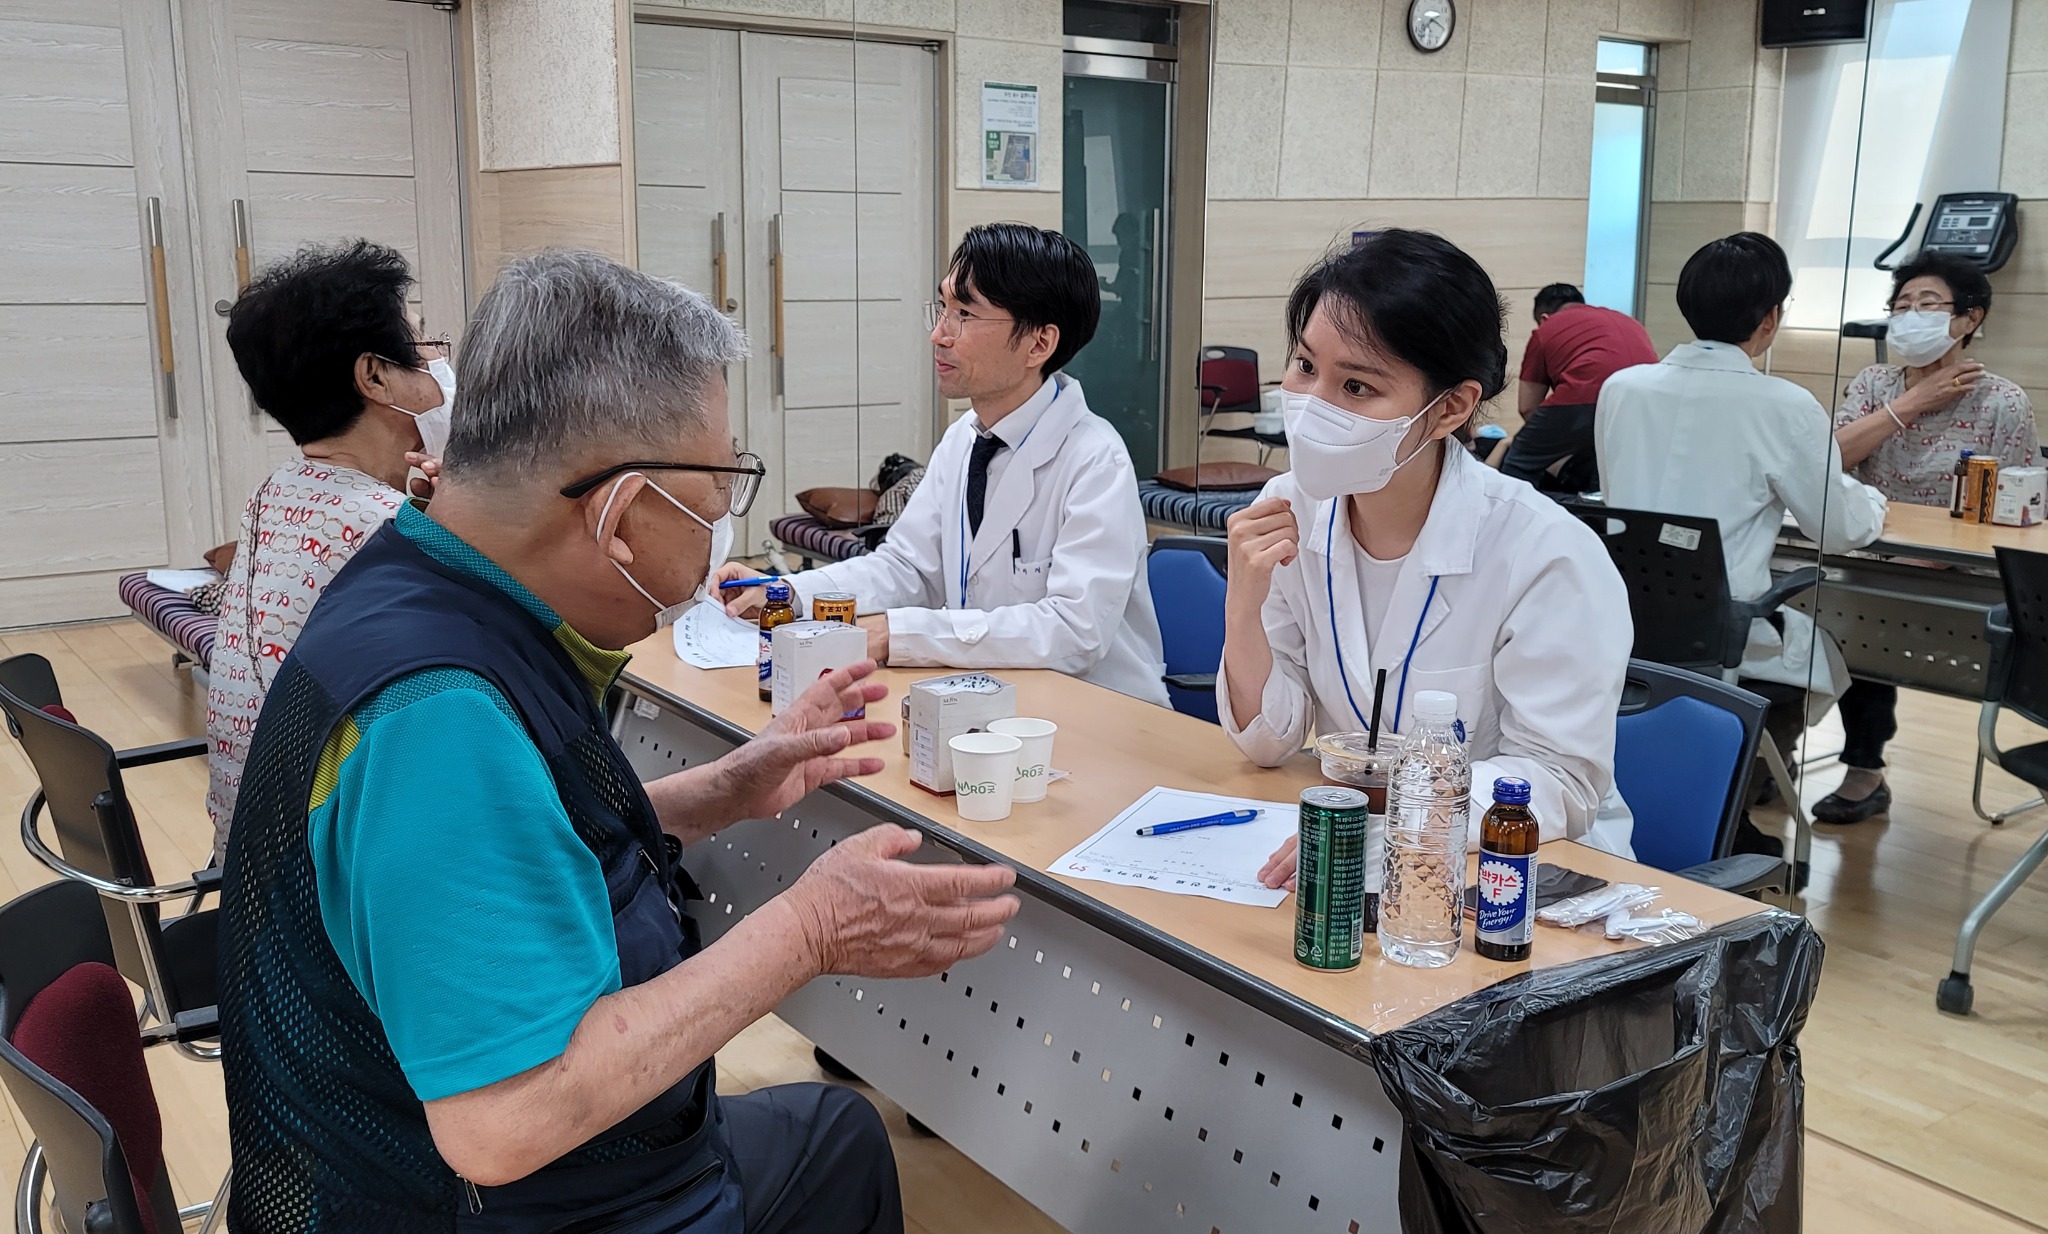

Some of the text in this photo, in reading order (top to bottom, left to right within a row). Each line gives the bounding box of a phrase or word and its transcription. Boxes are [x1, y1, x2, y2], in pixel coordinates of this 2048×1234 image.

[1482, 868, 1517, 888] 박카스
[1492, 887, 1503, 899] F
[1479, 907, 1517, 920] Drive Your
[1482, 915, 1513, 929] Energy!
